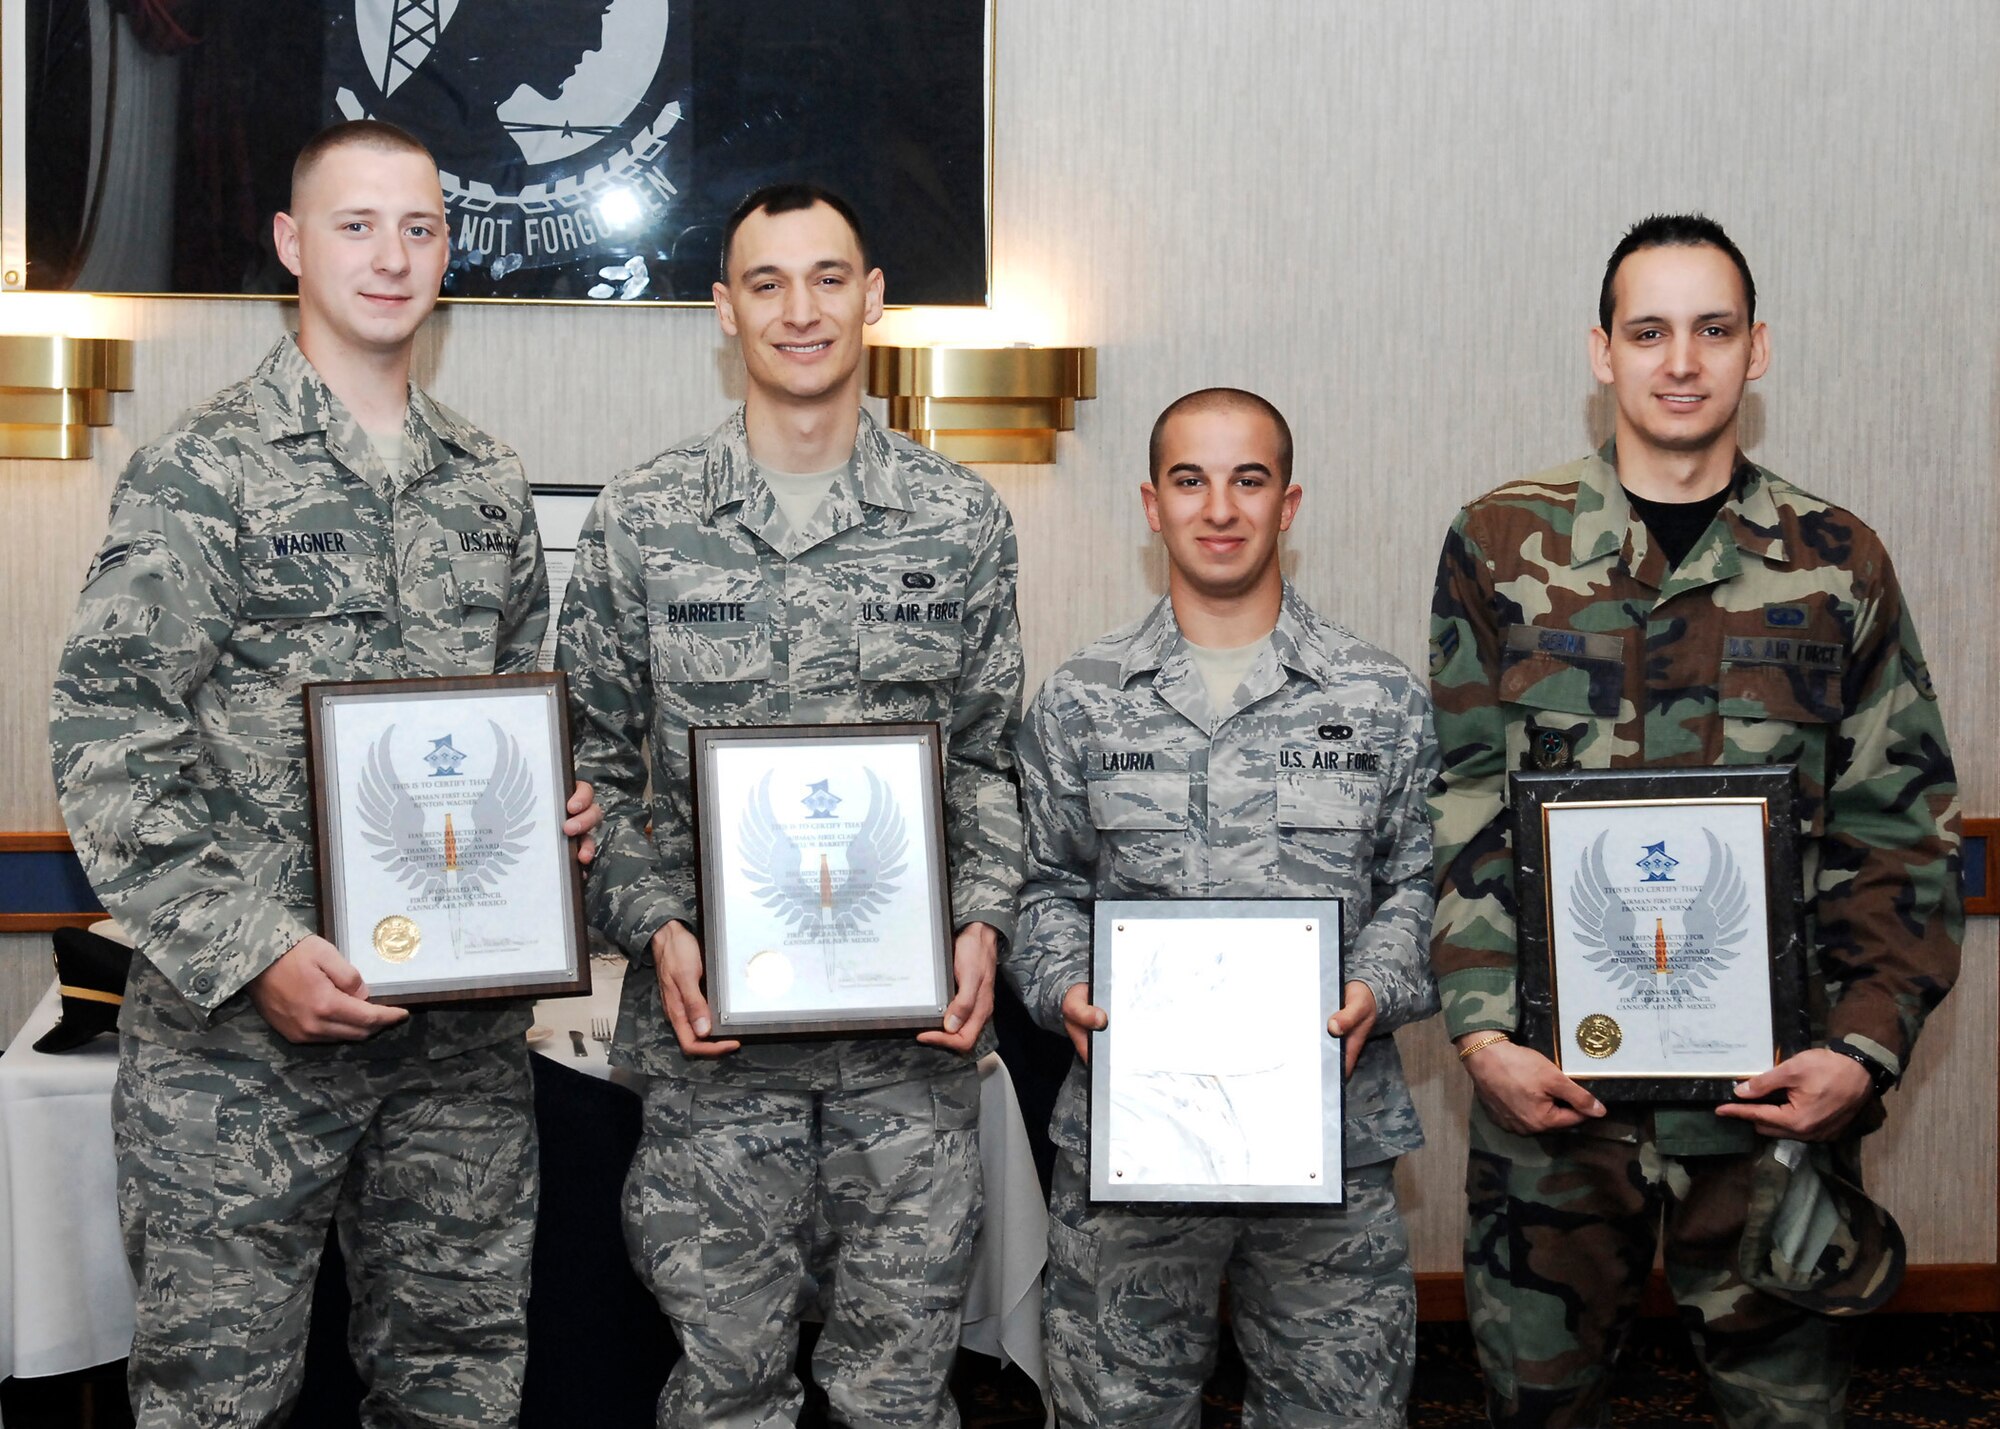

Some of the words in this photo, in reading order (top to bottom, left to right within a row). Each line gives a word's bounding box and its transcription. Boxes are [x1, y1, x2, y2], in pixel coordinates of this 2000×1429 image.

[458, 214, 512, 256] NOT
[525, 166, 678, 256] FORGOEN
[272, 532, 347, 556] WAGNER
[486, 533, 506, 554] AIR
[668, 602, 745, 622] BARRETTE
[862, 603, 888, 622] U.S.
[894, 603, 920, 622] AIR
[927, 601, 960, 621] FORCE
[1102, 753, 1155, 770] LAURIA
[1280, 751, 1306, 768] U.S.
[1312, 751, 1339, 769] AIR
[1346, 752, 1378, 771] FORCE
[434, 780, 466, 788] CERTIFY
[410, 793, 440, 801] AIRMAN
[477, 899, 507, 907] MEXICO
